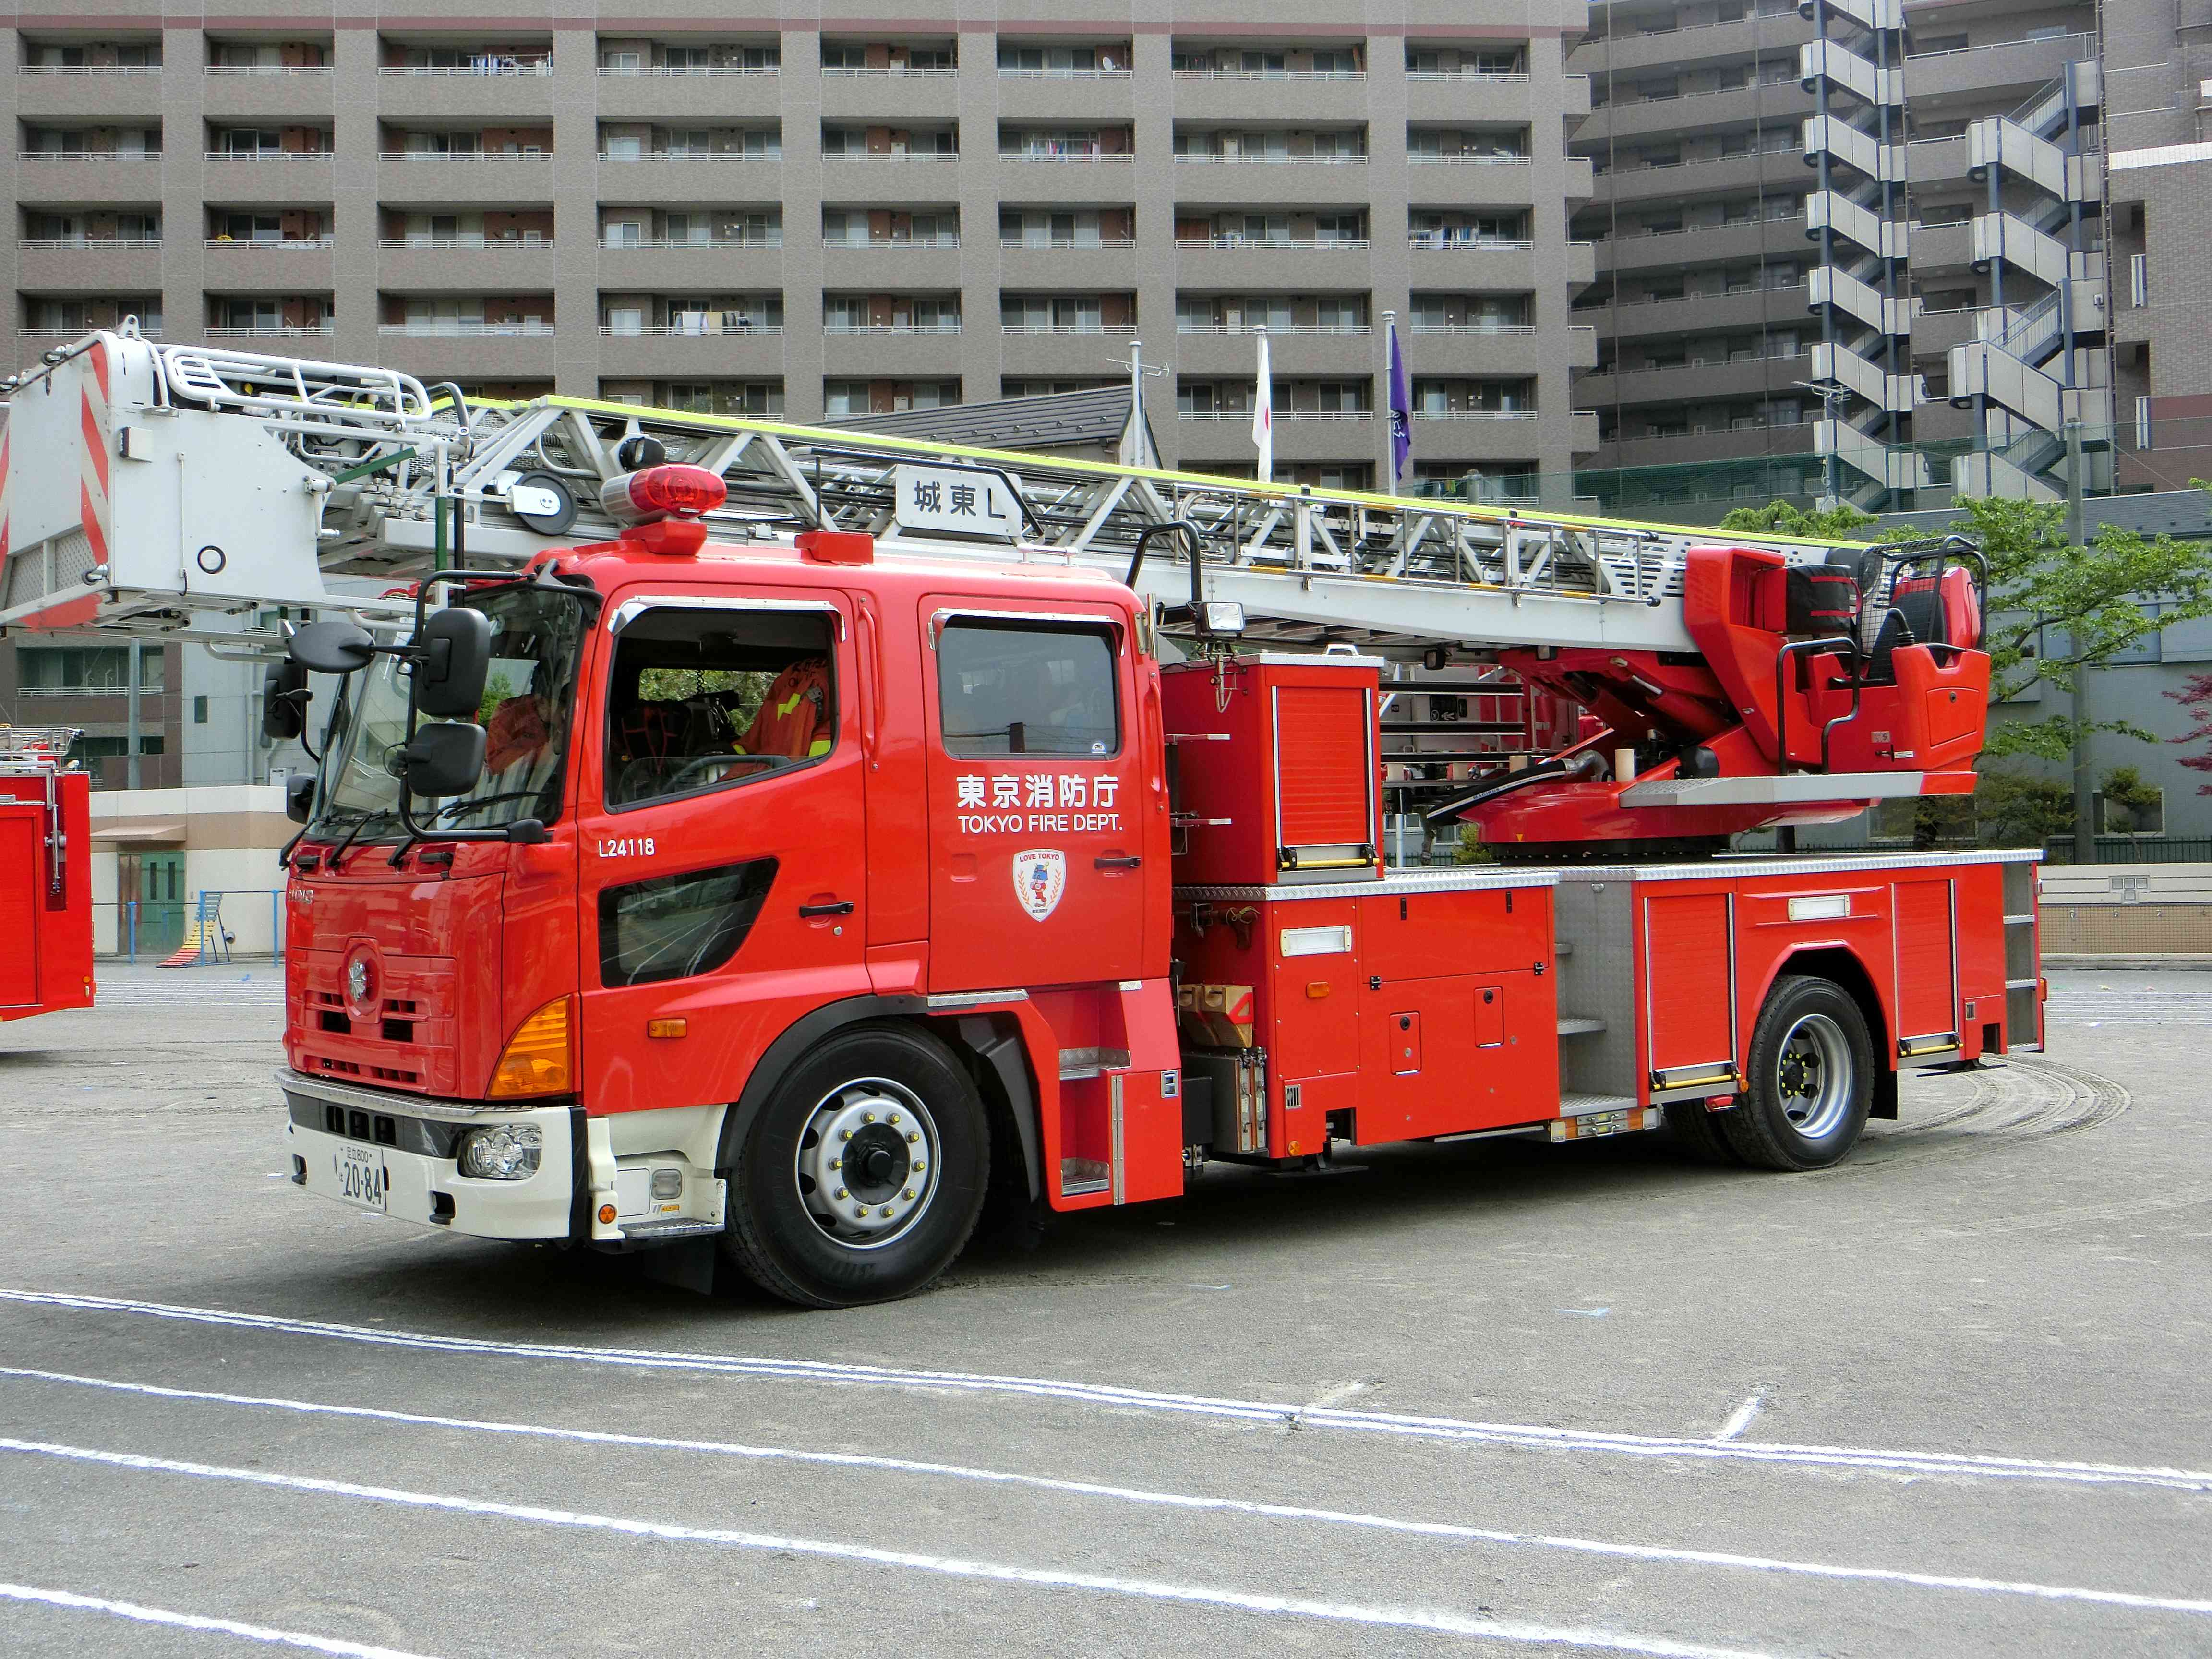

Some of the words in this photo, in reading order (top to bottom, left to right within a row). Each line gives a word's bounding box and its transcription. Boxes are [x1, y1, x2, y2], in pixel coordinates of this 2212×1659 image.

[914, 480, 1007, 519] 城東L
[956, 774, 1118, 809] 東京消防庁
[957, 814, 1023, 834] TOKYO
[1028, 814, 1069, 832] FIRE
[1073, 813, 1123, 831] DEPT.
[598, 837, 655, 857] L24118
[1019, 853, 1036, 863] LOVE
[344, 1161, 382, 1205] 20-84
